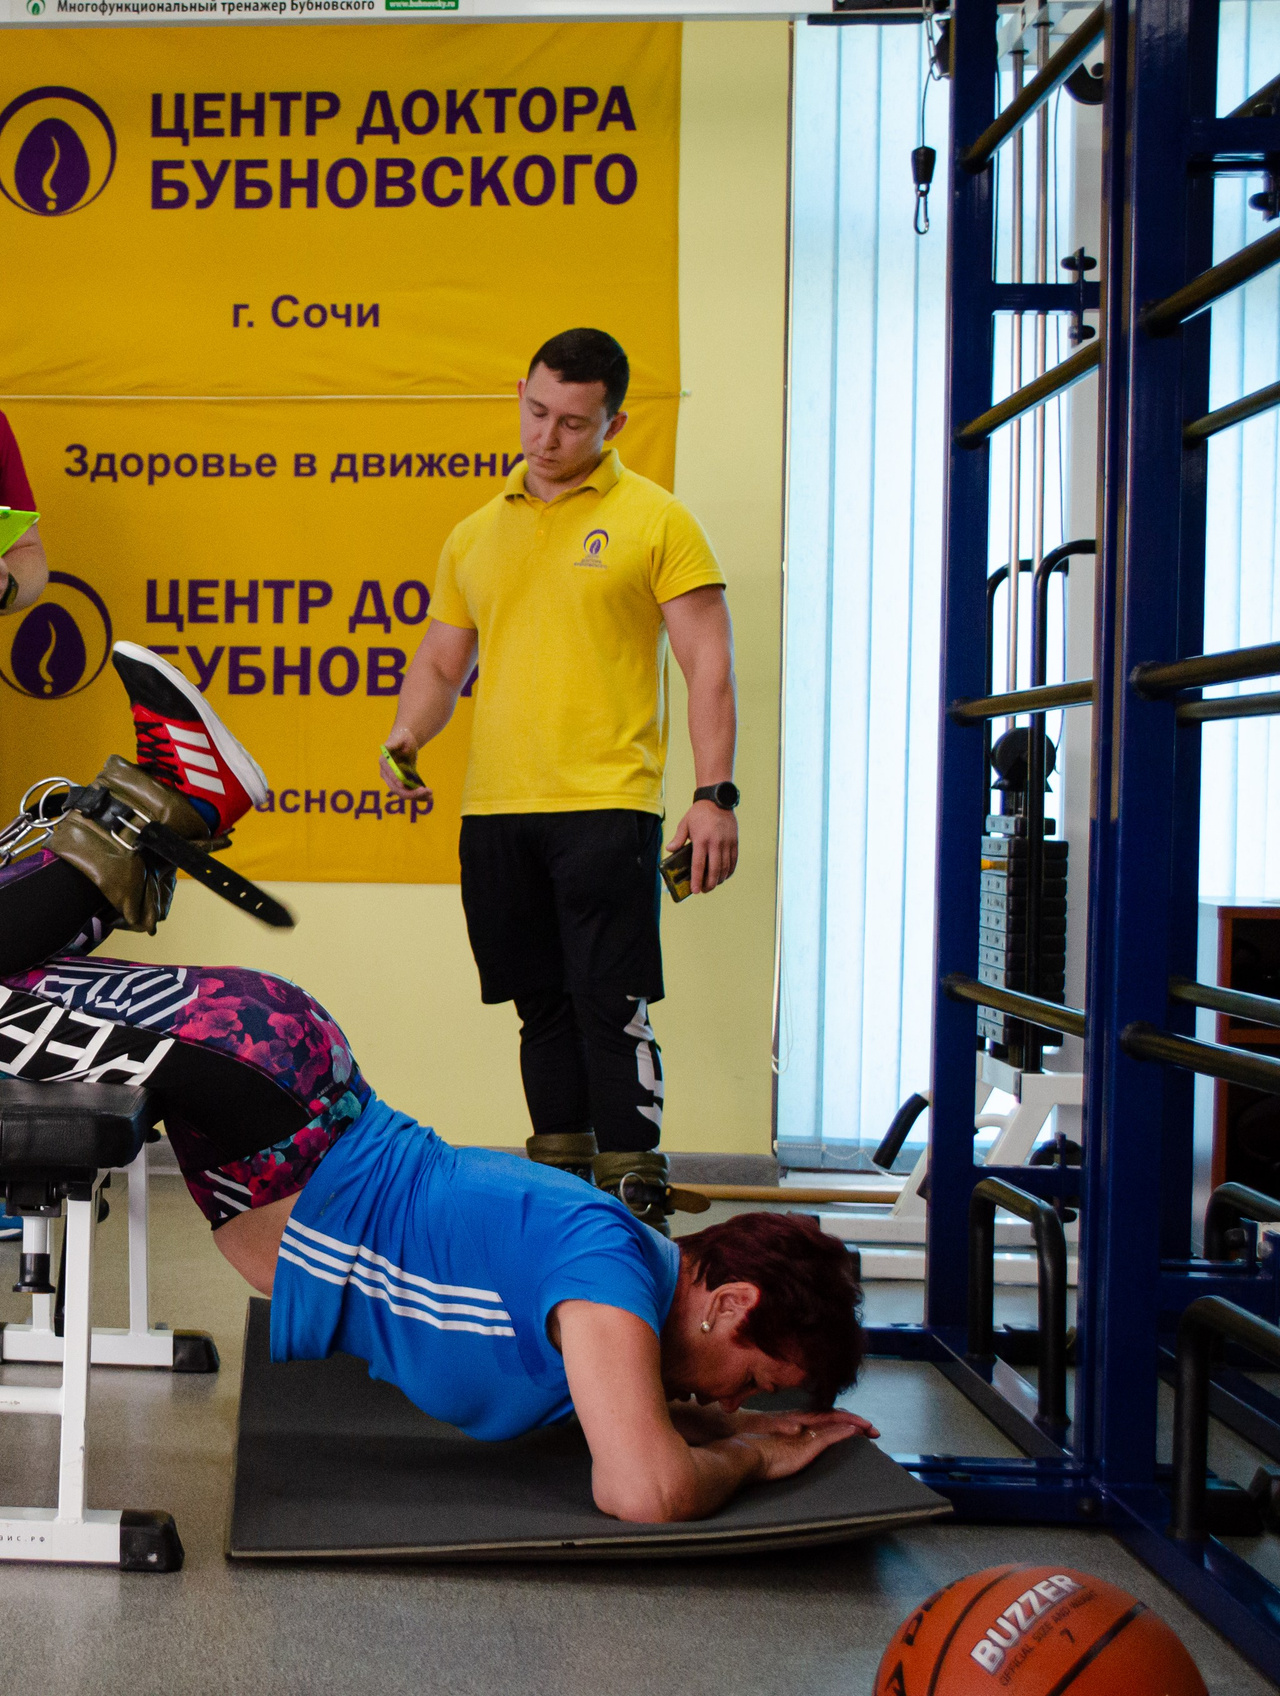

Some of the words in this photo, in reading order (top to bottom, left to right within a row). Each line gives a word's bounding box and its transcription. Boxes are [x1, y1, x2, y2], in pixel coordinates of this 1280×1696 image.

[57, 0, 217, 15] Многофункциональный
[221, 1, 287, 14] тренажер
[290, 0, 375, 13] Бубновского
[151, 92, 341, 147] ЦЕНТР
[356, 85, 637, 145] ДОКТОРА
[151, 152, 638, 210] БУБНОВСКОГО
[232, 303, 255, 328] г.
[271, 294, 381, 328] Сочи
[64, 443, 278, 486] Здоровье
[293, 453, 318, 478] в
[330, 453, 525, 483] движени
[145, 578, 333, 633] ЦЕНТР
[254, 788, 434, 823] аснодар
[969, 1573, 1085, 1676] BUZZER
[1059, 1627, 1076, 1645] 7
